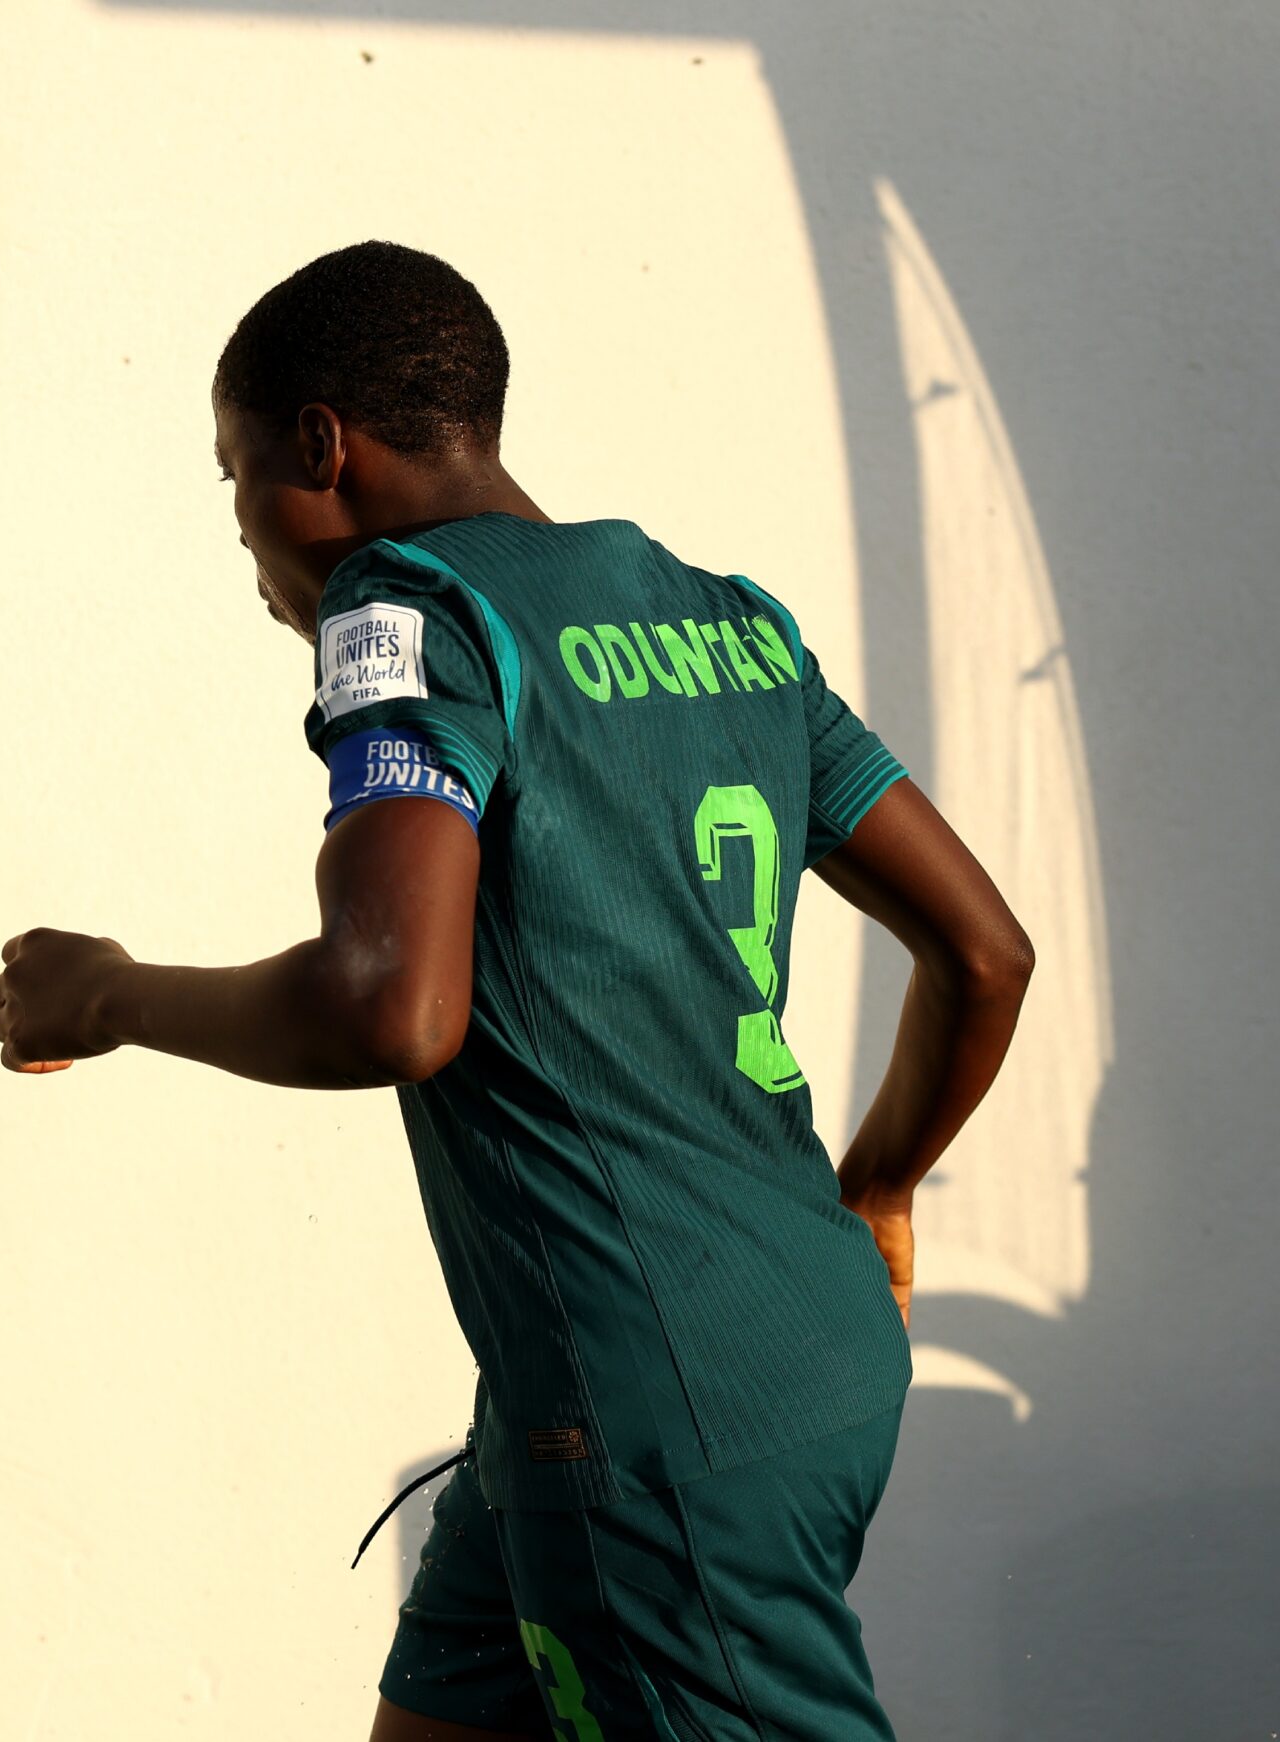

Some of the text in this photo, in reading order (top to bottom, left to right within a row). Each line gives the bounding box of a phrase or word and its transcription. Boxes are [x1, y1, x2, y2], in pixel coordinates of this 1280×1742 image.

[336, 620, 400, 647] FOOTBALL
[335, 634, 400, 669] UNITES
[559, 614, 799, 703] ODUNTAN
[331, 660, 406, 691] the World
[352, 687, 381, 701] FIFA
[366, 739, 441, 766] FOOTB
[363, 762, 476, 810] UNITES
[694, 785, 808, 1094] 3
